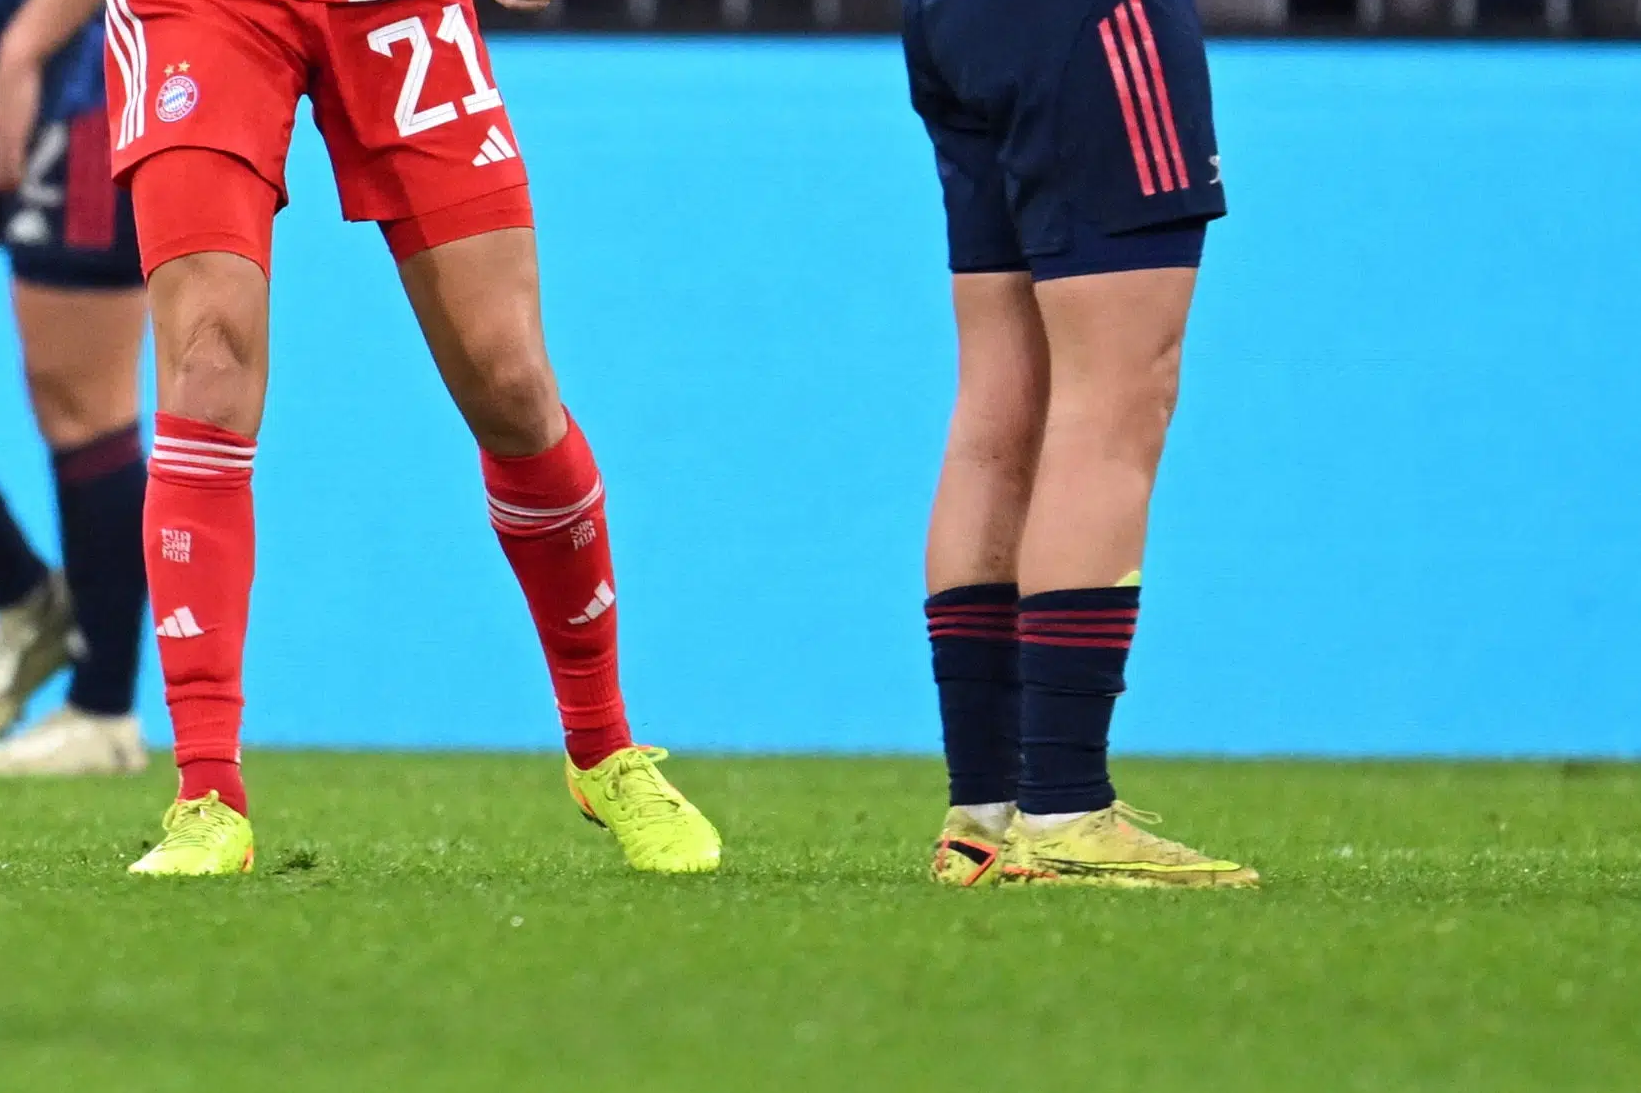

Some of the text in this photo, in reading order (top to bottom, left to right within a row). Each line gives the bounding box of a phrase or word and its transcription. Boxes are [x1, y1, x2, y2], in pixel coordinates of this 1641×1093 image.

[366, 3, 503, 138] 21
[161, 528, 191, 541] MIA
[162, 539, 190, 552] SAN
[162, 550, 190, 563] MIA
